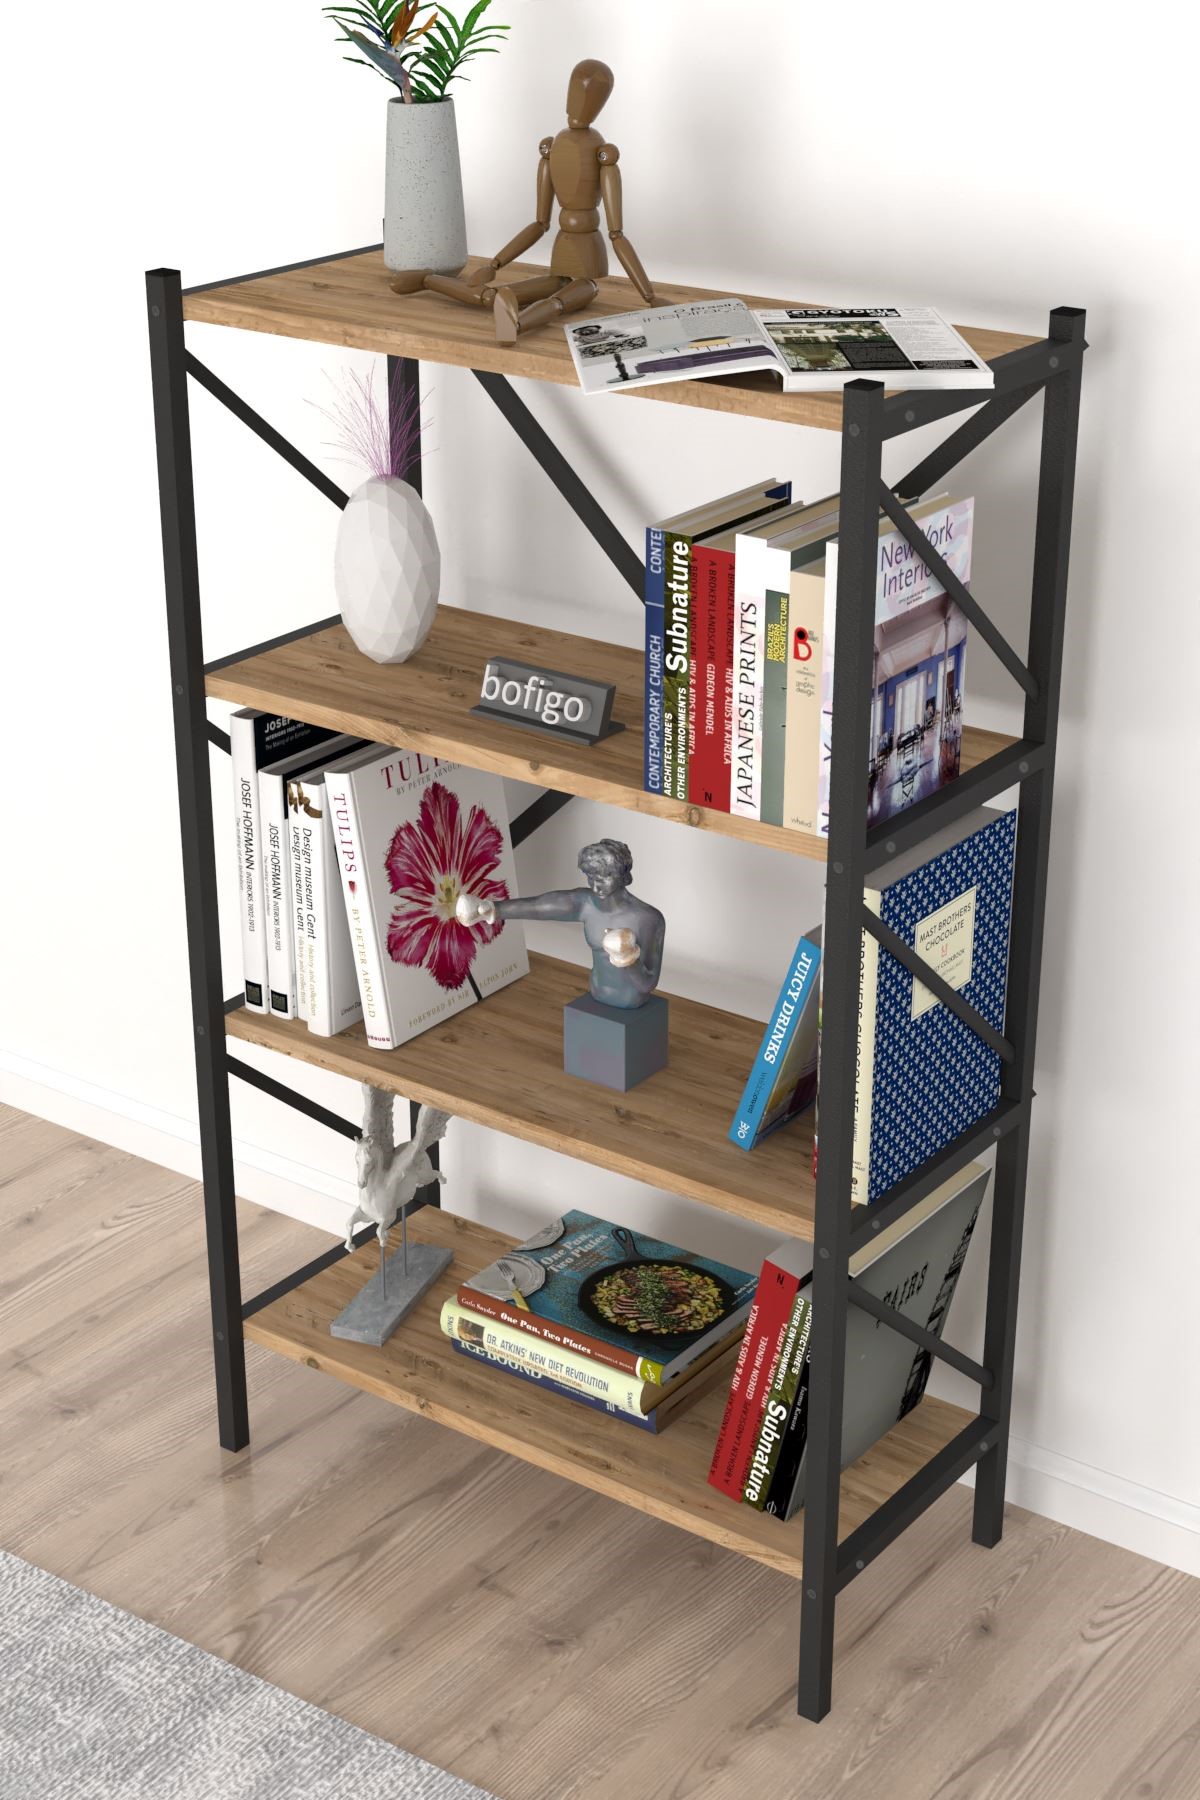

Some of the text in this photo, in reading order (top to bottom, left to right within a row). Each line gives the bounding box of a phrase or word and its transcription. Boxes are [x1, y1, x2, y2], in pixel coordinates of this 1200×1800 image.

[650, 527, 662, 574] CONTE
[881, 542, 914, 572] New
[707, 569, 717, 603] BROKEN
[665, 541, 689, 674] Subnature
[767, 623, 775, 660] BRAZIL'S
[772, 624, 781, 662] MODERN
[779, 597, 788, 664] ARCHITECTURE
[689, 659, 697, 678] HIV
[705, 663, 716, 700] GIDEON
[725, 668, 734, 686] HIV
[480, 664, 584, 725] bofigo
[648, 634, 662, 790] CONTEMPORARY CHURCH
[689, 688, 697, 711] AIDS
[724, 694, 734, 718] AIDS
[736, 602, 757, 808] JAPANESE PRINTS
[688, 712, 696, 722] IN
[705, 702, 715, 736] MENDEL
[724, 720, 734, 730] IN
[663, 712, 673, 797] ARCHITECTURE'S
[677, 687, 687, 800] OTHER ENVIRONMENTS
[688, 724, 696, 755] AFRICA
[723, 732, 733, 765] AFRICA
[240, 777, 252, 809] JOSEF
[408, 774, 431, 791] PETER
[242, 810, 255, 871] HOFFMANN
[269, 822, 280, 849] JOSEF
[301, 828, 313, 864] Design
[271, 850, 282, 900] HOFFMANN
[294, 863, 303, 904] museum
[304, 866, 313, 912] museum
[333, 793, 376, 1018] TULIPS BY PETER ARNOLD
[919, 902, 972, 943] MAST BROTHERS
[306, 913, 317, 940] Gent
[925, 919, 965, 952] CHOCOLATE
[940, 948, 966, 969] COOKBOOK
[408, 1002, 446, 1028] FOREWORD
[763, 952, 813, 1065] JUICY DRINKS
[540, 1248, 567, 1265] One
[546, 1256, 575, 1273] Two
[571, 1234, 609, 1258] Plates
[476, 1303, 497, 1316] Snyder
[500, 1312, 518, 1324] One
[519, 1319, 541, 1334] Pan,
[542, 1328, 561, 1342] Two
[562, 1336, 592, 1355] Plates
[746, 1304, 760, 1335] AFRICA
[743, 1336, 751, 1347] IN
[774, 1297, 805, 1391] OTHER ENVIRONMENTS
[775, 1323, 788, 1353] AFRICA
[486, 1333, 498, 1347] DR.
[500, 1339, 528, 1358] ATKINS'
[529, 1351, 546, 1366] NEW
[548, 1359, 564, 1373] DIET
[565, 1366, 609, 1393] REVOLUTION
[735, 1367, 743, 1375] &
[737, 1346, 749, 1367] AIDS
[745, 1368, 760, 1400] GIDEON
[755, 1335, 769, 1368] MENDEL
[731, 1375, 741, 1391] HIV
[745, 1400, 788, 1503] Subnature
